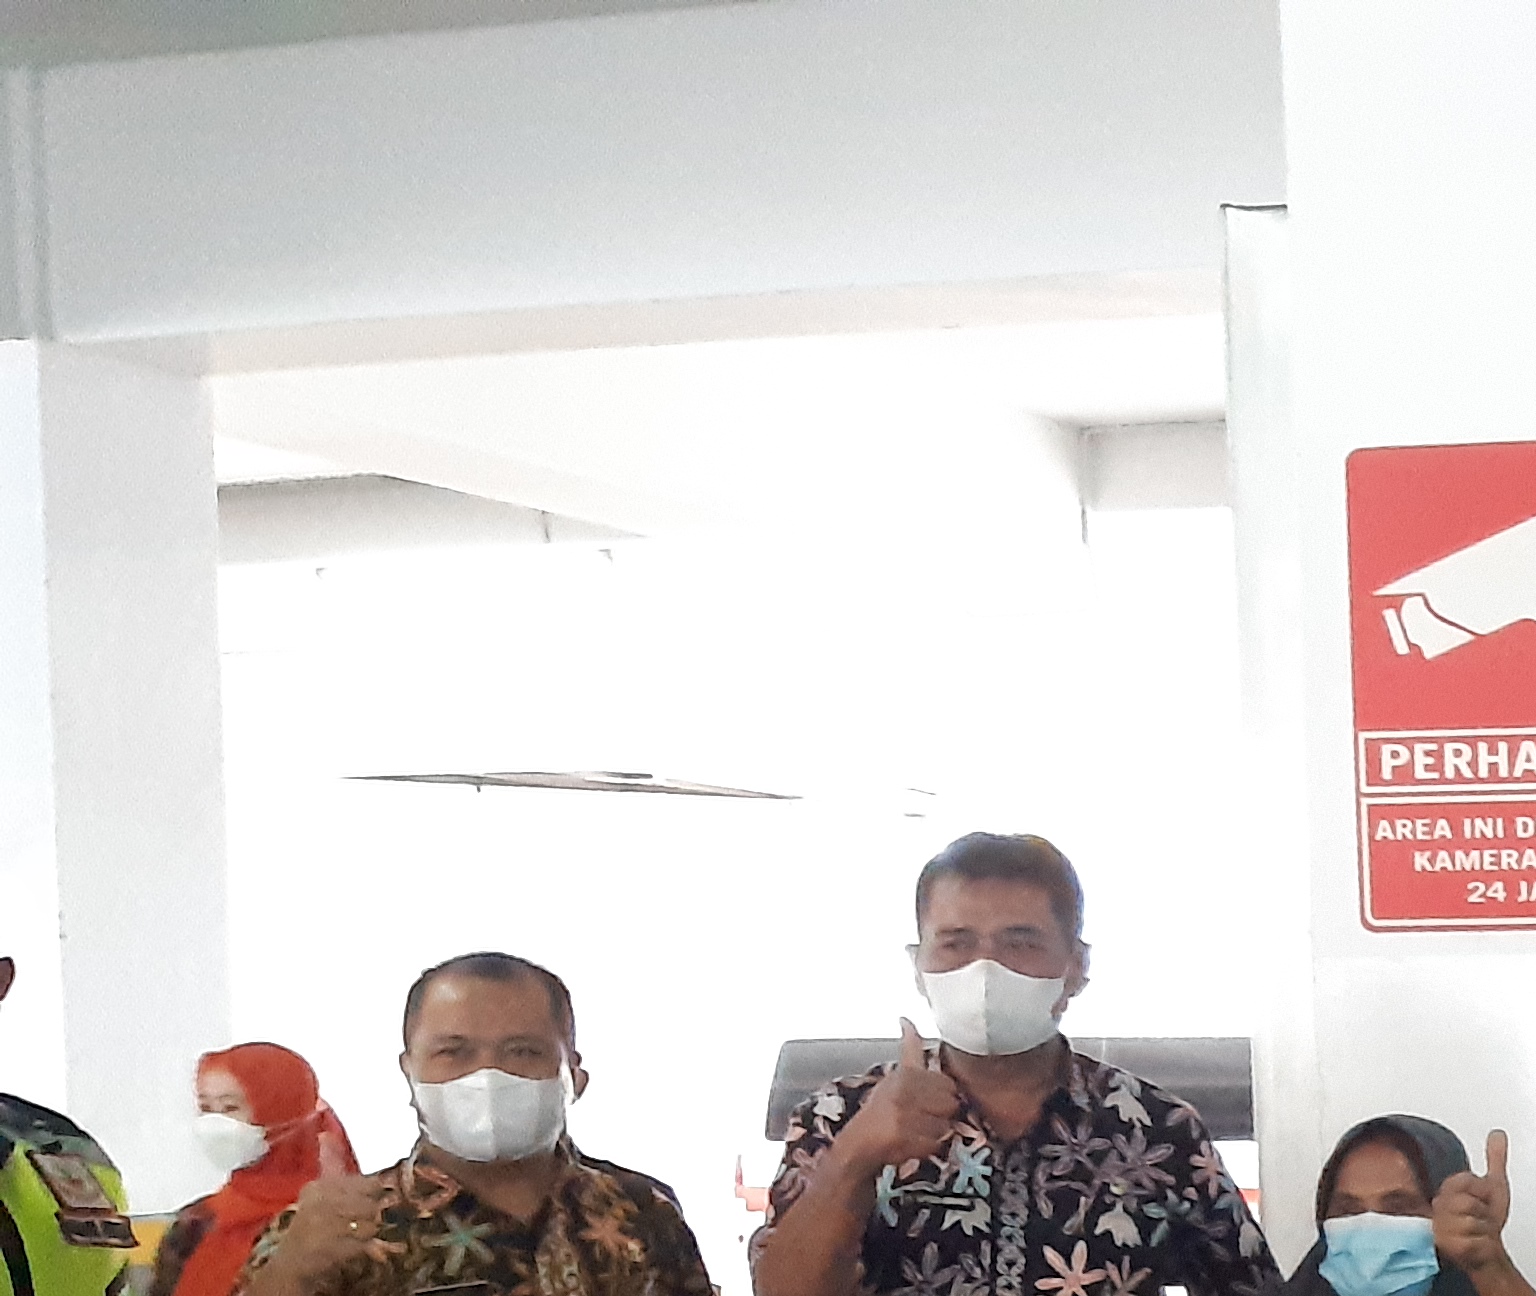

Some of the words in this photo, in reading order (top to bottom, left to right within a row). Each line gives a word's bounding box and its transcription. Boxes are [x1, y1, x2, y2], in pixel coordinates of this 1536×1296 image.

[1373, 817, 1454, 842] AREA
[1462, 816, 1505, 841] INI
[1466, 880, 1507, 904] 24
